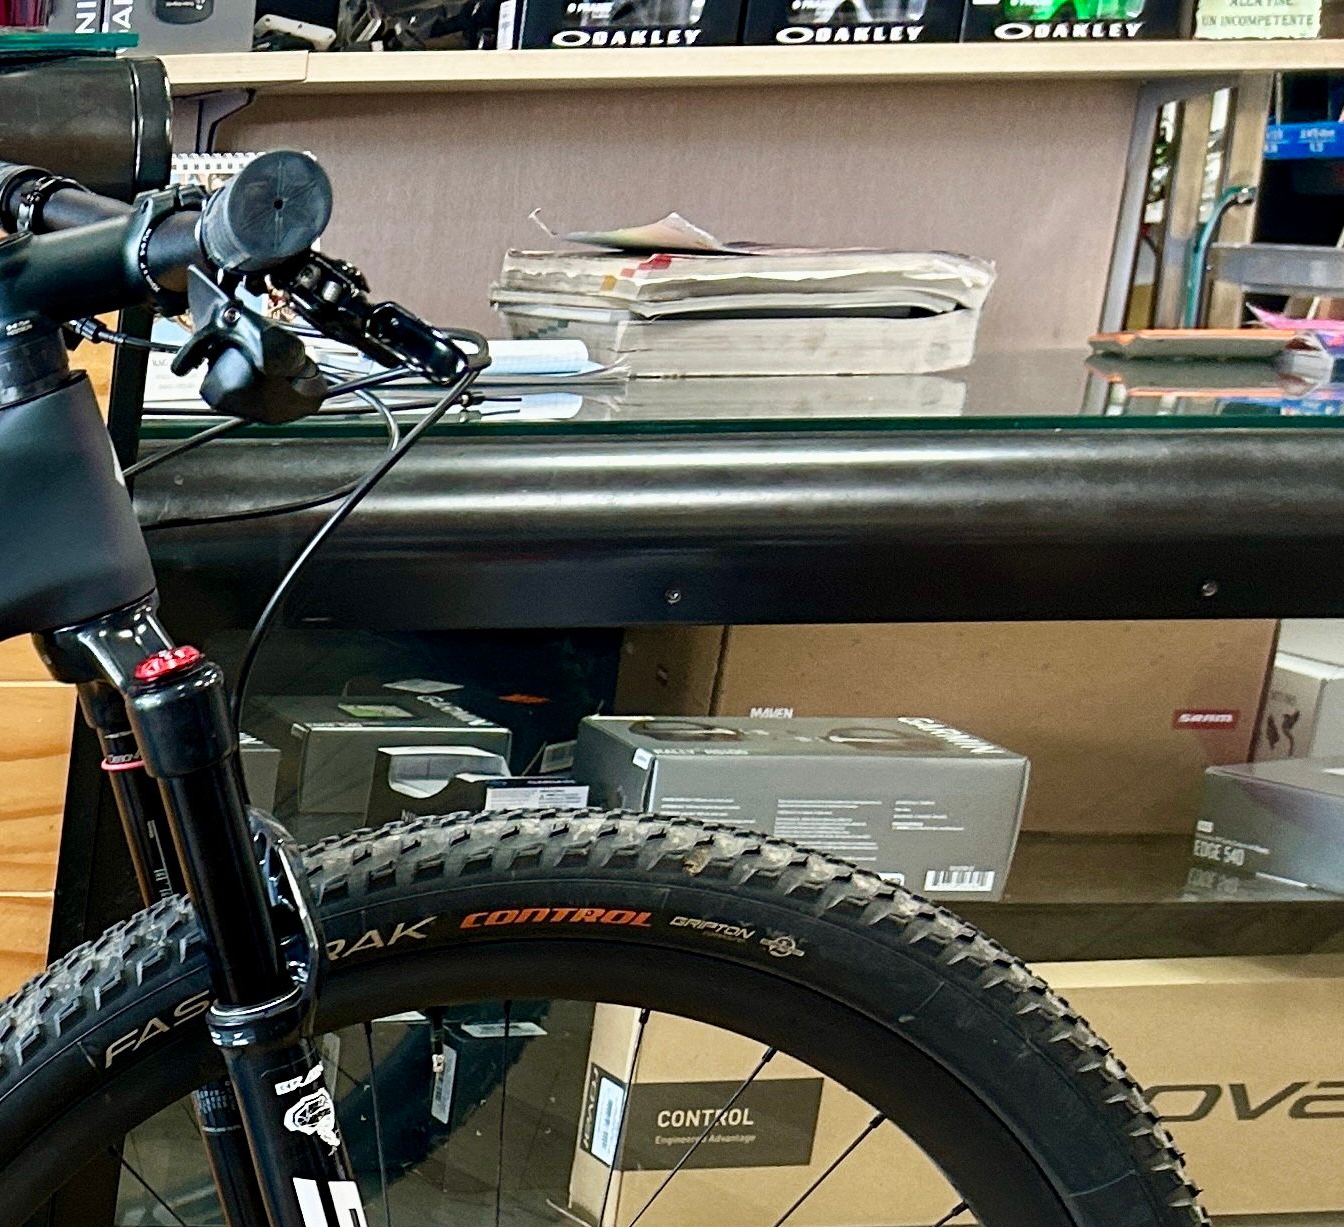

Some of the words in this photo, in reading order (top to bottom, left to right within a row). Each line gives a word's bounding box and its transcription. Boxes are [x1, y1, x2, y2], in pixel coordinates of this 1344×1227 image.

[1220, 14, 1313, 27] INCOMPETENTE
[592, 31, 702, 46] OAKLEY
[816, 26, 923, 43] OAKLEY
[1035, 22, 1145, 39] OAKLEY
[460, 906, 653, 929] CONTROL
[669, 915, 756, 940] GRIPTON
[657, 1108, 755, 1129] CONTROL
